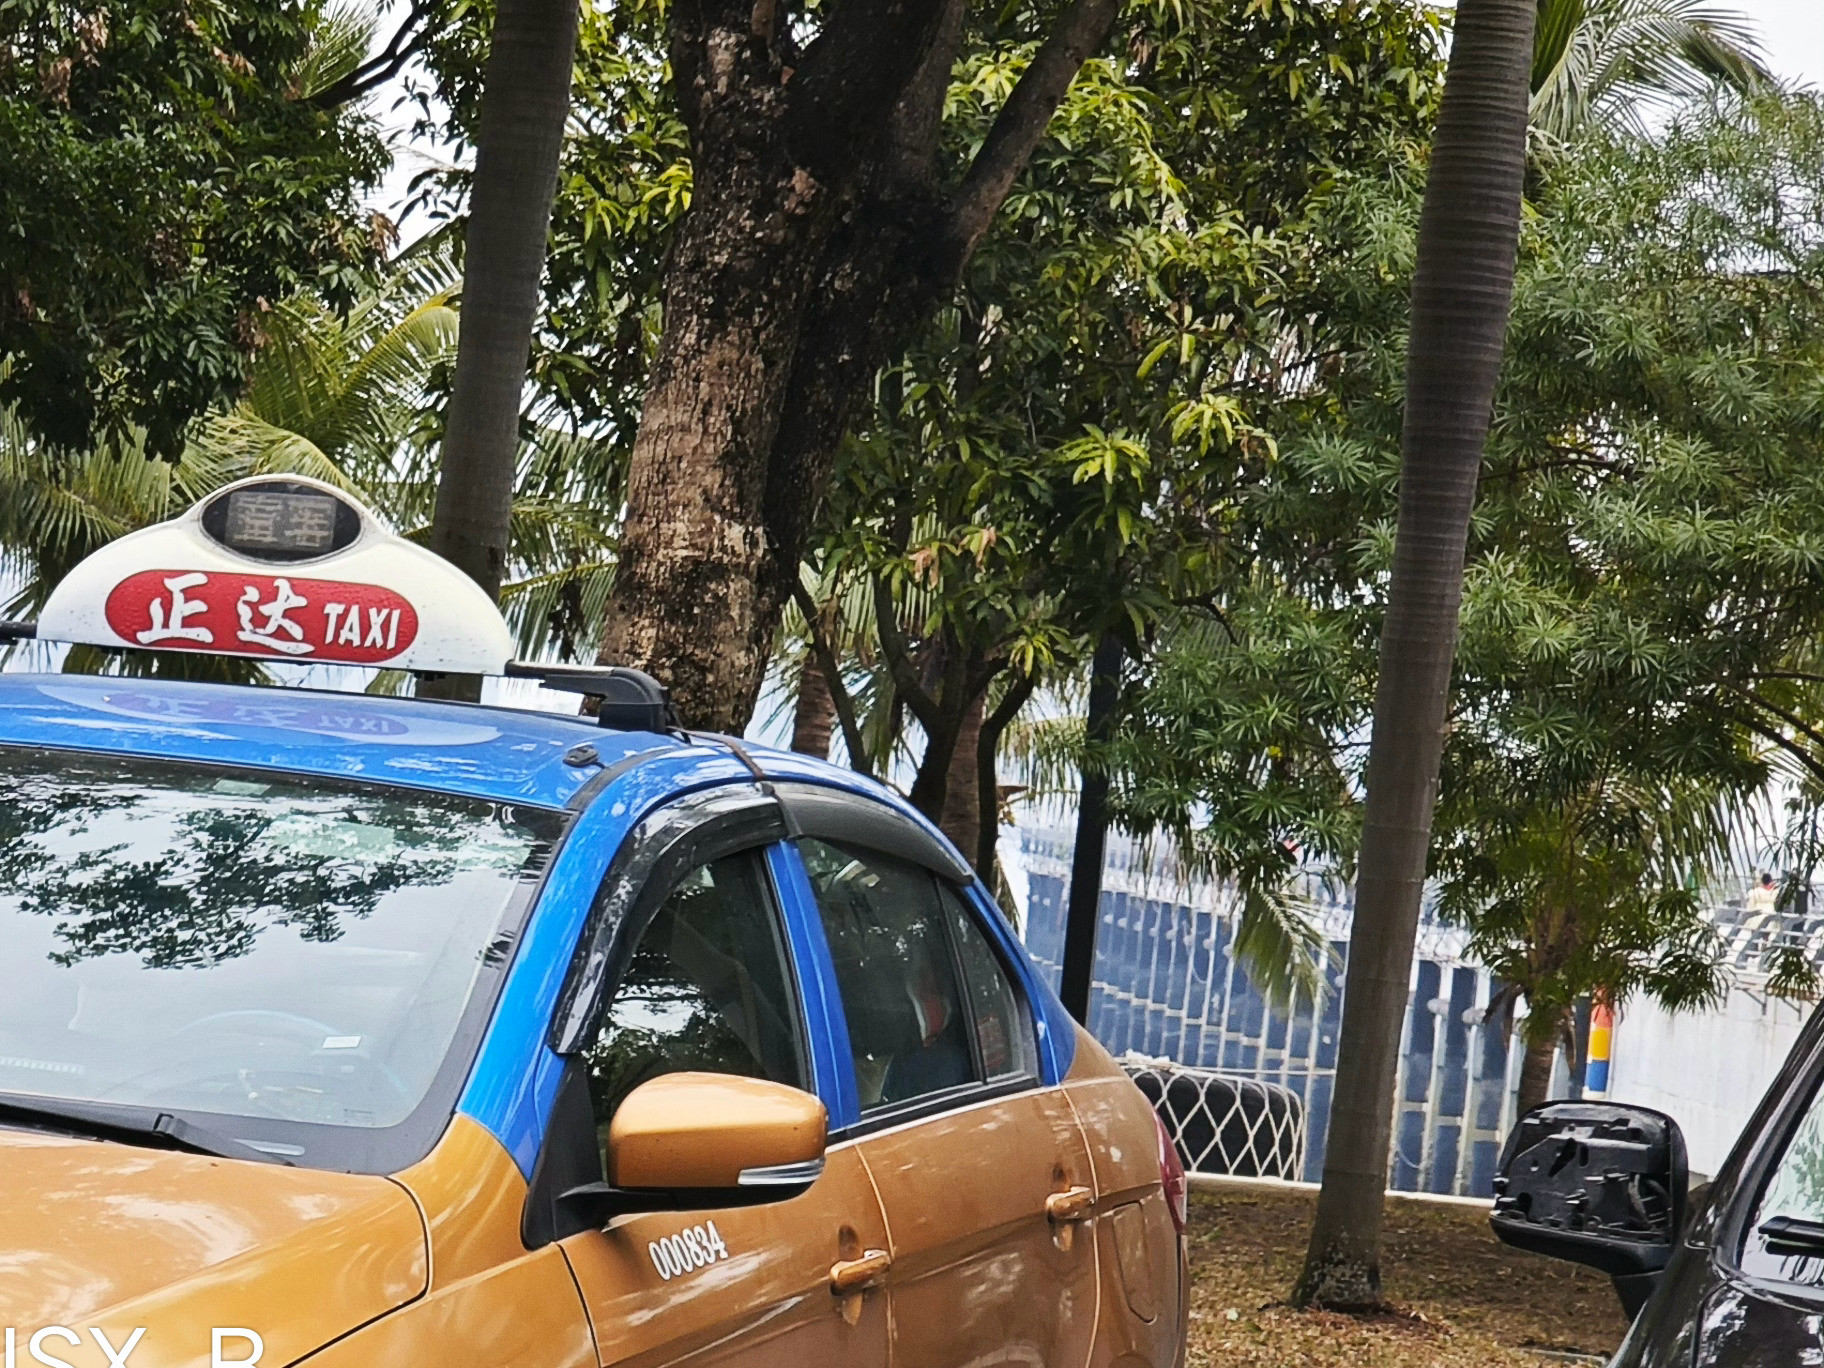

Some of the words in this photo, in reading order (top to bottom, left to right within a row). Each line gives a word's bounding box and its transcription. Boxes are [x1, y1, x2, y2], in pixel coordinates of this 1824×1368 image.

[136, 572, 315, 654] 正达
[324, 603, 401, 650] TAXI
[648, 1220, 728, 1280] 000834
